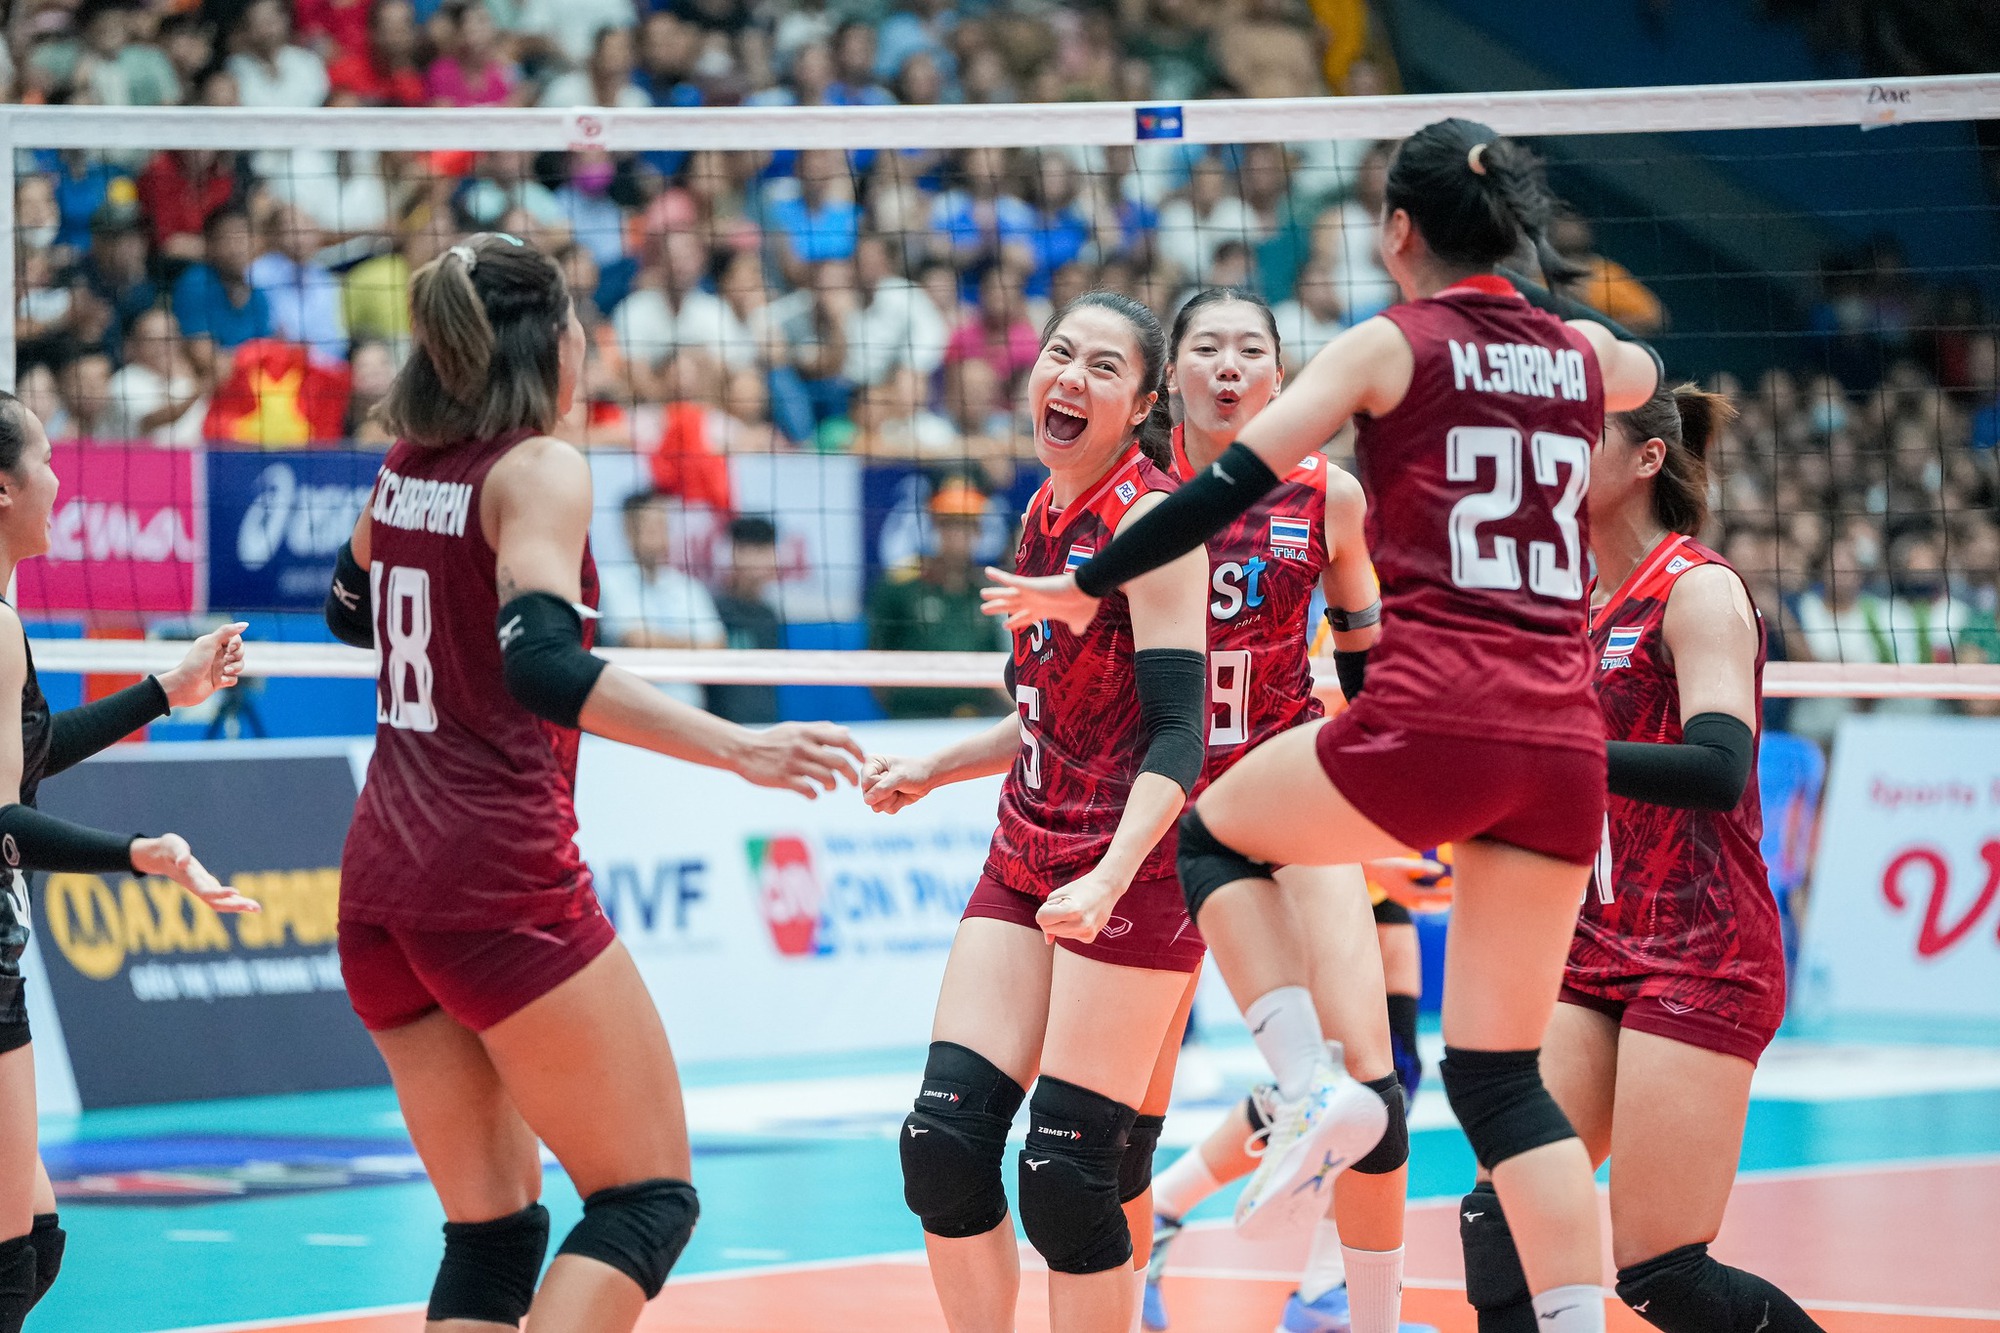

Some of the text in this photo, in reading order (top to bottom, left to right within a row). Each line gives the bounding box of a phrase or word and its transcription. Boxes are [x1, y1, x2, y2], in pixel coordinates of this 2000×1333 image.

[1448, 339, 1587, 401] M.SIRIMA
[1118, 483, 1134, 502] PEA
[1446, 426, 1590, 600] 23
[1270, 546, 1309, 562] THA
[1210, 556, 1268, 621] st
[369, 560, 439, 732] 18
[1601, 655, 1632, 670] THA
[1208, 650, 1252, 746] 9
